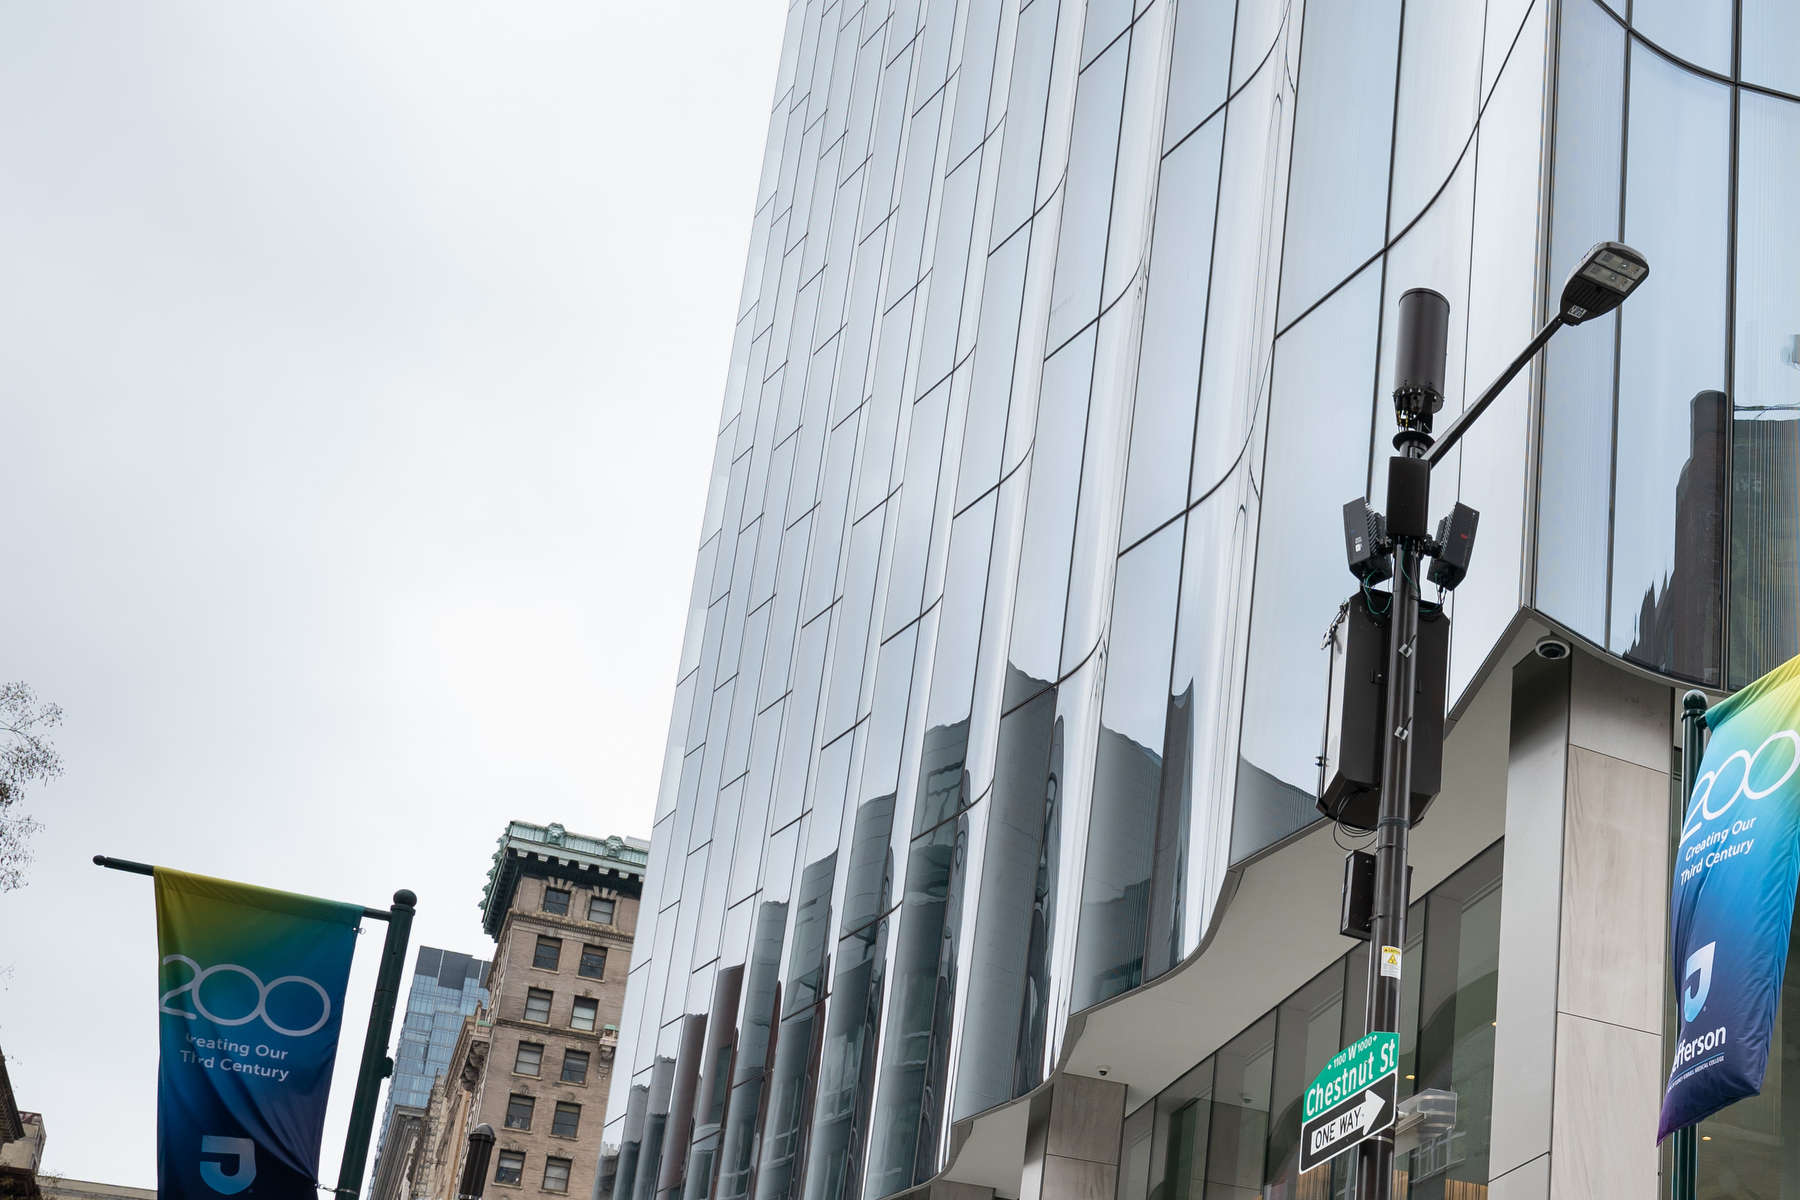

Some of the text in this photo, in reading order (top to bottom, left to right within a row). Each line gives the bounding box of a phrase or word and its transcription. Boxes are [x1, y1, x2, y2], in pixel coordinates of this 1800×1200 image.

[1685, 816, 1757, 861] Creating Our
[1680, 837, 1755, 886] Third Century
[159, 954, 331, 1037] 200
[180, 1050, 290, 1083] Thrd Century
[255, 1043, 289, 1061] Our
[1333, 1036, 1373, 1068] 1100 W 1000
[1670, 1026, 1727, 1079] efferson
[1306, 1038, 1395, 1117] Chestnut St
[1315, 1106, 1362, 1150] ONE WAY
